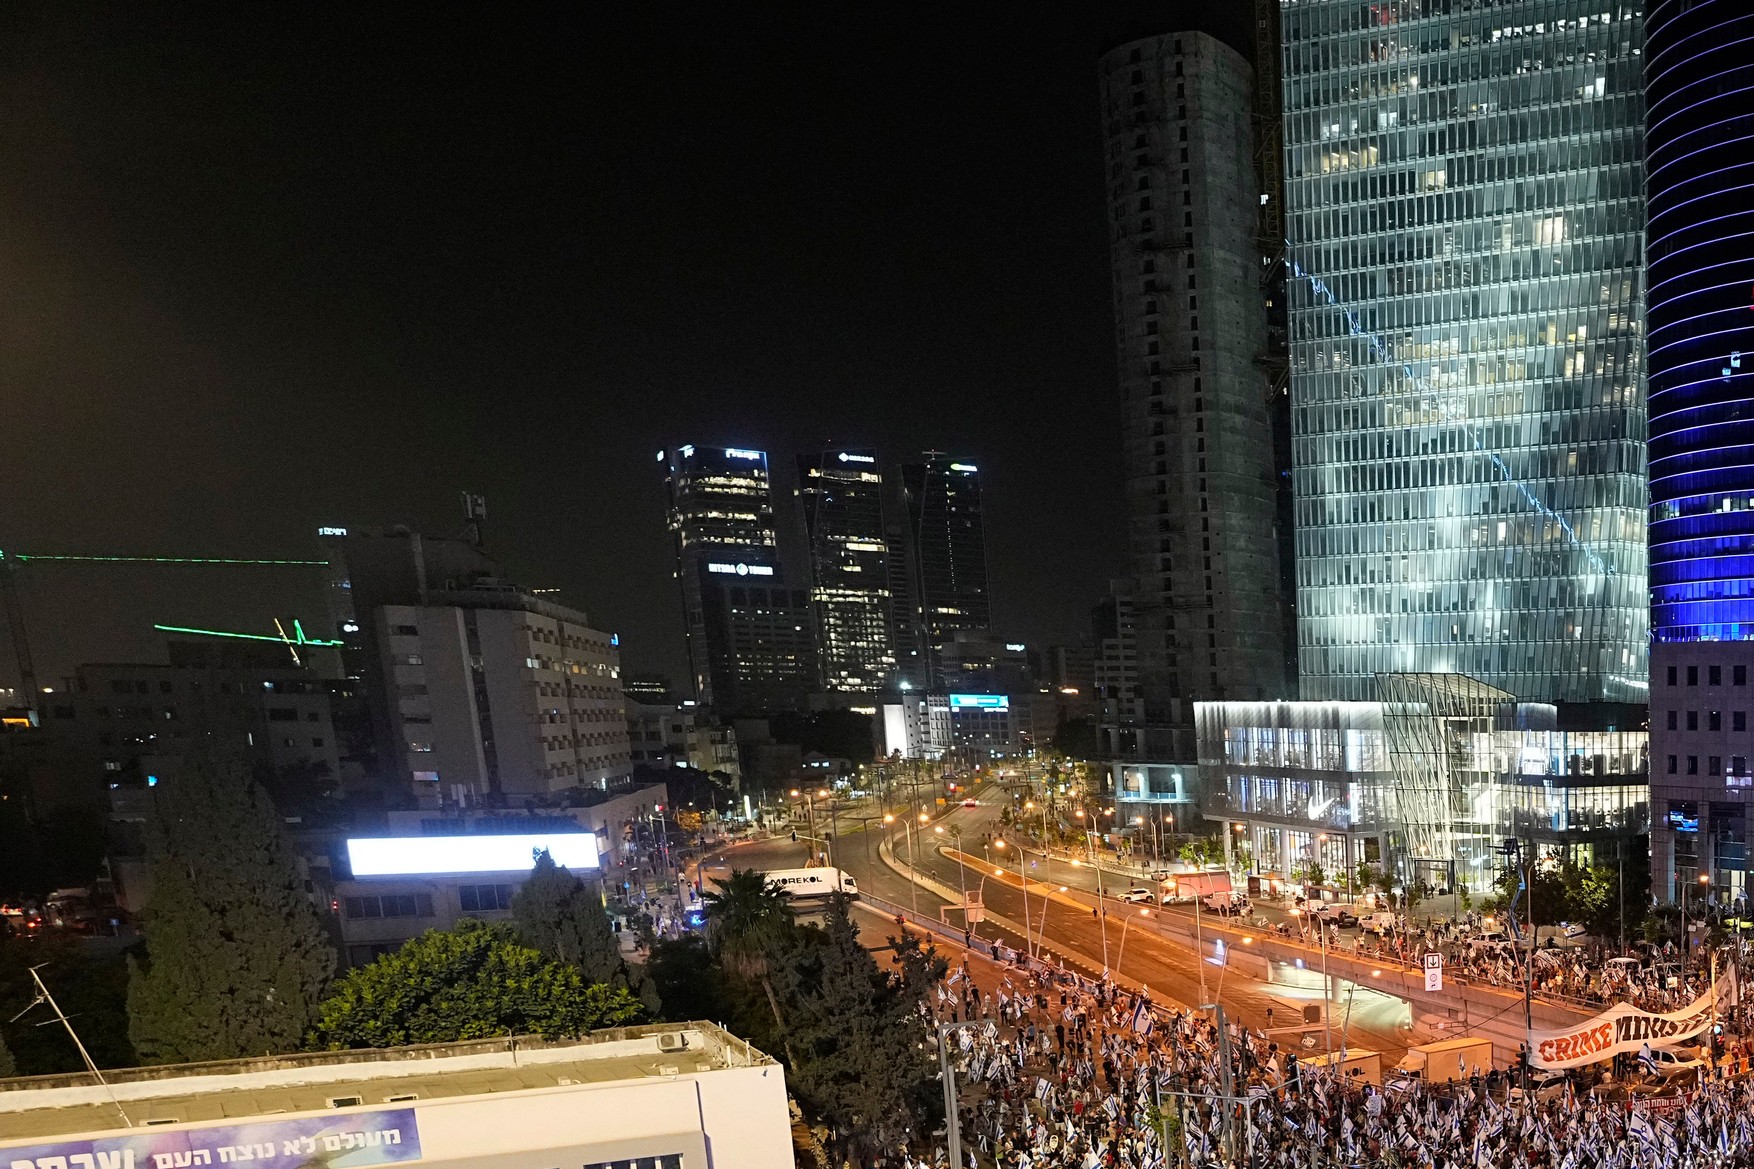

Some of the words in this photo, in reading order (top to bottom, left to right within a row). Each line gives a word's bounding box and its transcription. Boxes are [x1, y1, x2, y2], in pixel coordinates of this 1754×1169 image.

[1538, 1022, 1613, 1062] CRIME
[283, 1136, 317, 1157] לא
[322, 1127, 401, 1151] מעולם
[153, 1148, 212, 1169] העם
[217, 1142, 275, 1163] נוצח
